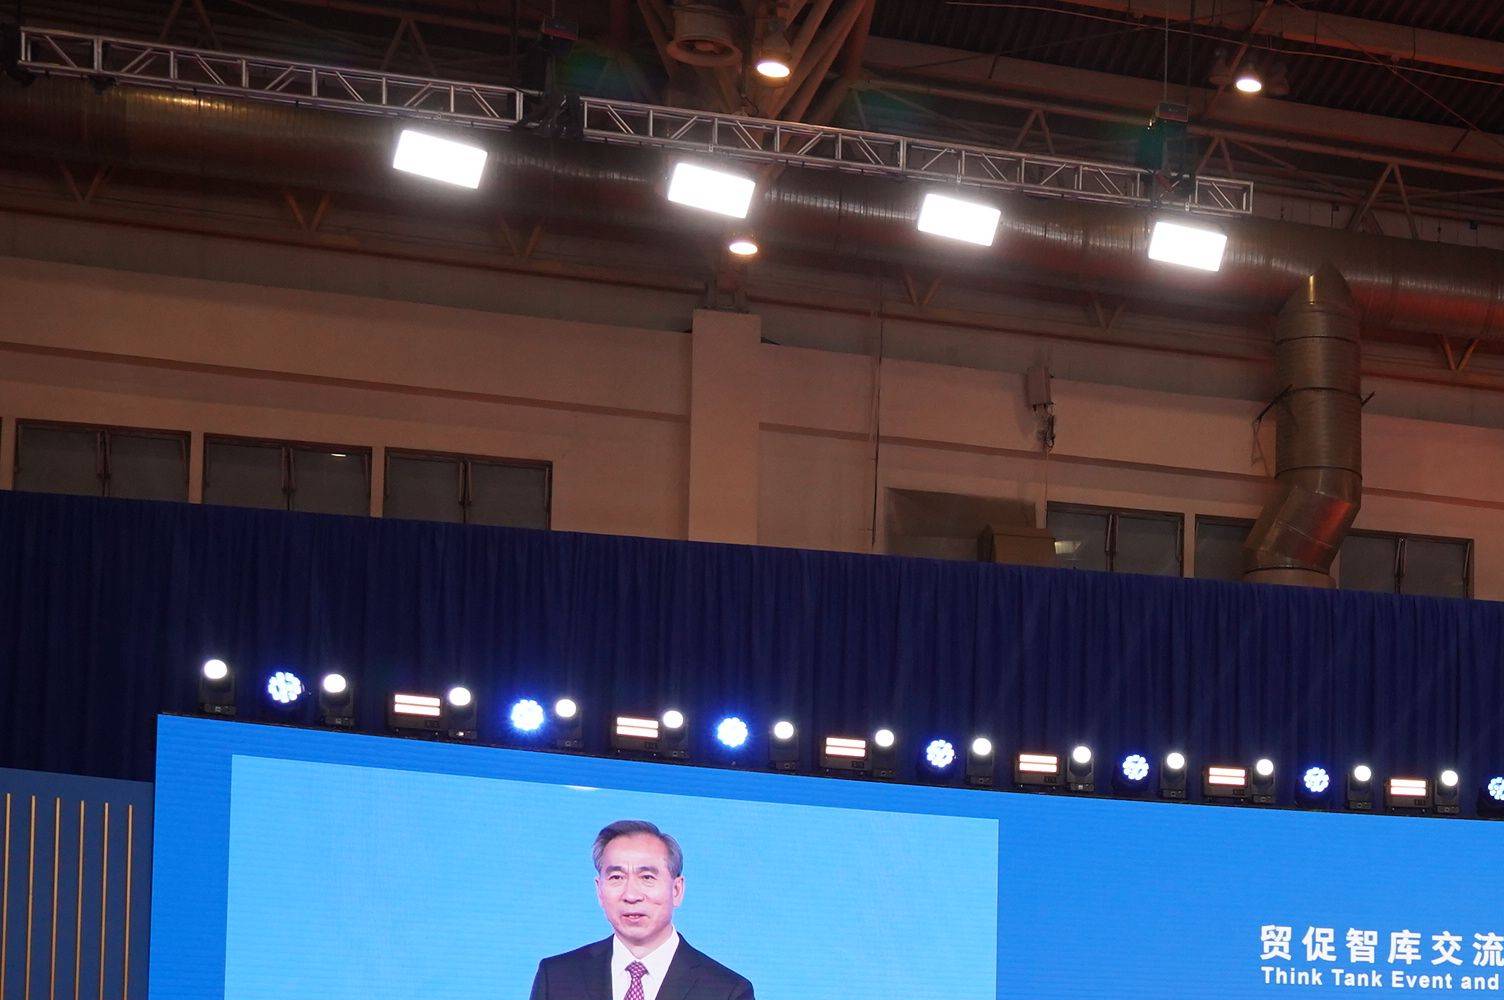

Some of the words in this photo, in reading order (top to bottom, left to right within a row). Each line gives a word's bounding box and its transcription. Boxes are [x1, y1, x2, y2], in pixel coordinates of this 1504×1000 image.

[1261, 966, 1322, 985] Think
[1331, 968, 1382, 987] Tank
[1391, 970, 1452, 989] Event
[1461, 973, 1499, 991] and
